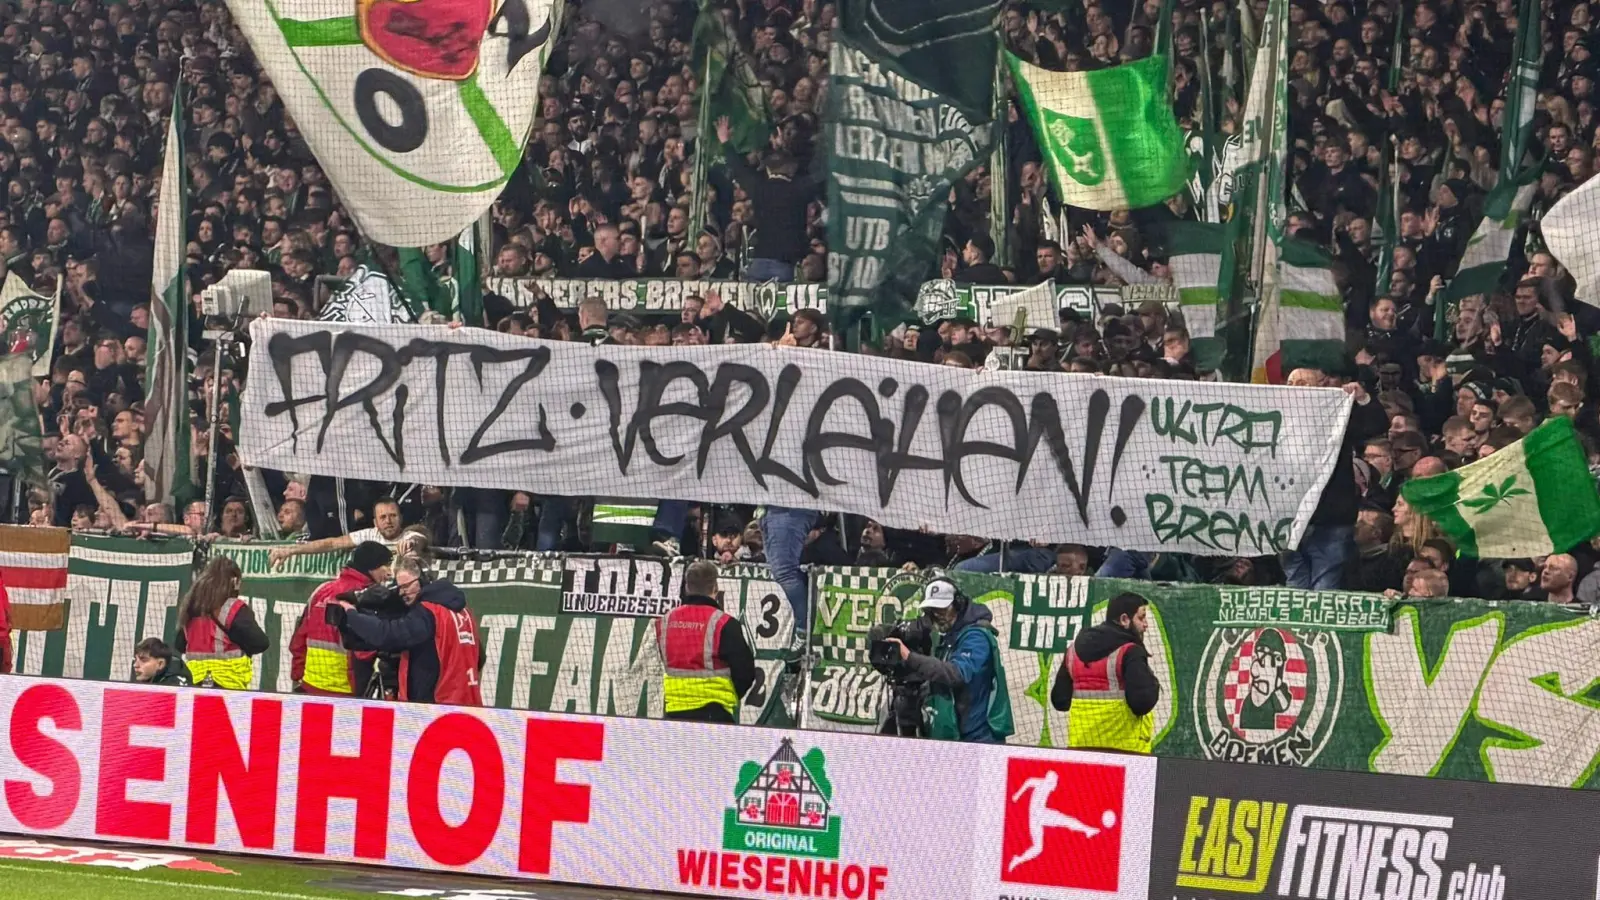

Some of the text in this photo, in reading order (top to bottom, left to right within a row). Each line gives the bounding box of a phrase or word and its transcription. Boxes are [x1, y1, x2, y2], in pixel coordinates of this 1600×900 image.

[846, 216, 891, 250] UTB
[265, 331, 556, 472] FRITZ
[1160, 456, 1272, 515] TEAM
[1145, 494, 1294, 554] BREME
[669, 621, 704, 630] SECURITY
[756, 594, 781, 639] 3
[1219, 608, 1290, 622] NIEMALS
[3, 683, 605, 875] SENHOF
[744, 831, 818, 853] ORIGINAL
[1176, 796, 1506, 900] EASY FITNESS club
[677, 849, 888, 900] WIESENHOF
